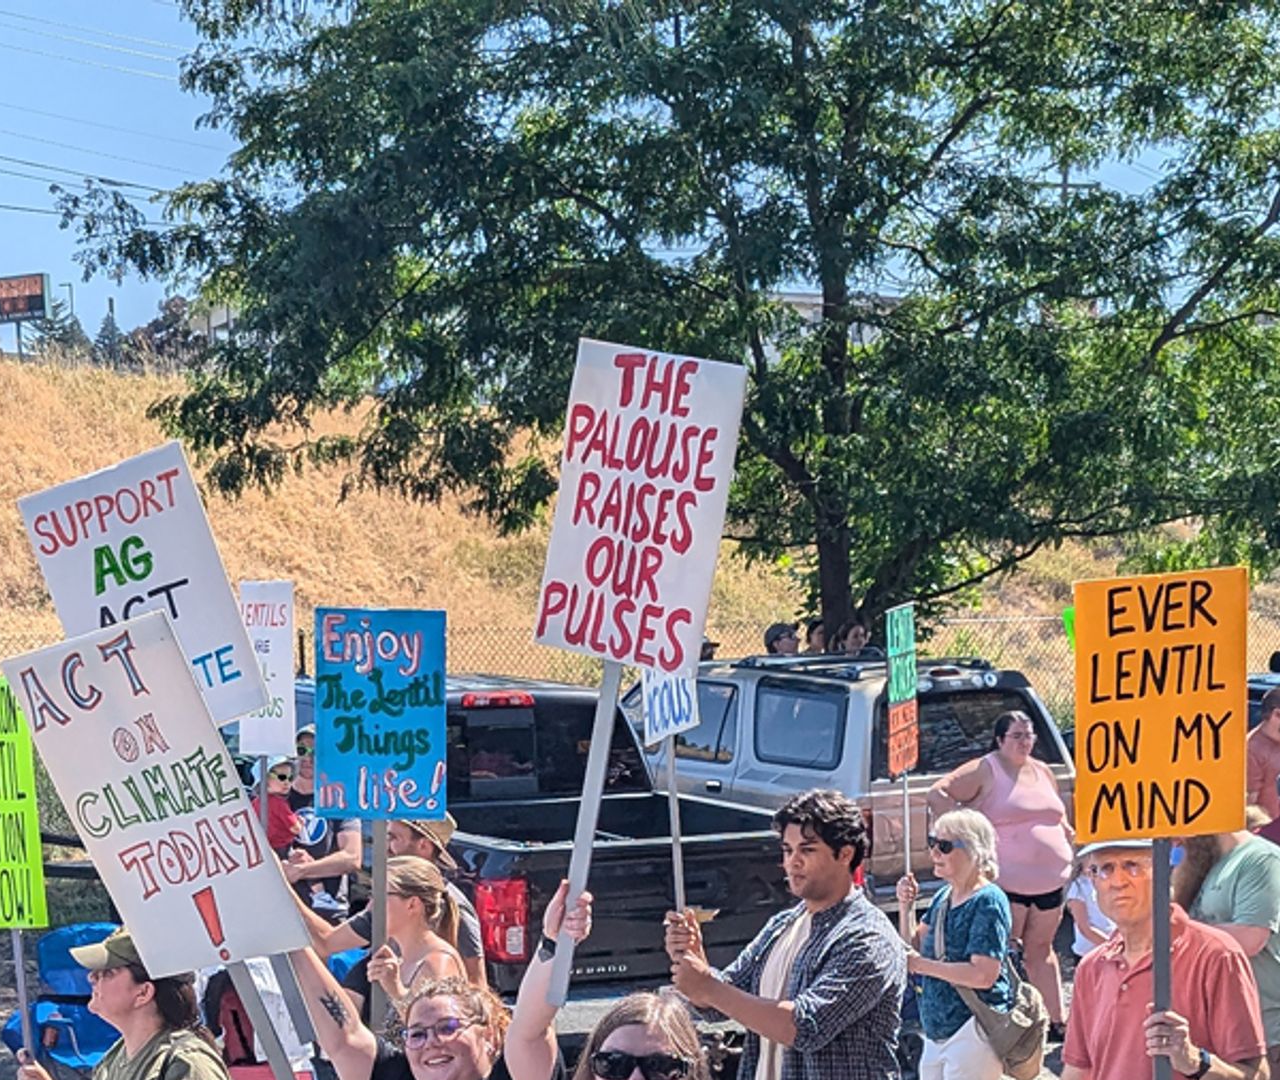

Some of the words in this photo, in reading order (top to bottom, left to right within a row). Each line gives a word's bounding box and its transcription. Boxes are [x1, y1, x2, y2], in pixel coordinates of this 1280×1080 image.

[614, 353, 699, 418] THE
[565, 403, 719, 493] PALOUSE
[34, 468, 179, 556] SUPPORT
[572, 470, 698, 556] RAISES
[93, 535, 153, 596] AG
[586, 535, 664, 601] OUR
[536, 580, 693, 673] PULSES
[1108, 580, 1218, 637] EVER
[192, 644, 242, 688] TE
[254, 639, 271, 654] RE
[322, 613, 423, 677] Enjoy
[1090, 644, 1226, 704] LENTIL
[19, 630, 152, 732] ACT
[316, 671, 366, 712] The
[367, 668, 446, 718] Lentil
[112, 712, 171, 763] ON
[333, 715, 433, 773] Things
[1086, 718, 1141, 774] ON
[1172, 710, 1233, 764] MY
[75, 746, 241, 839] CLIMATE
[319, 774, 347, 811] in
[358, 760, 447, 813] life!
[1091, 779, 1211, 835] MIND
[118, 808, 265, 901] TODAY
[191, 884, 232, 962] !
